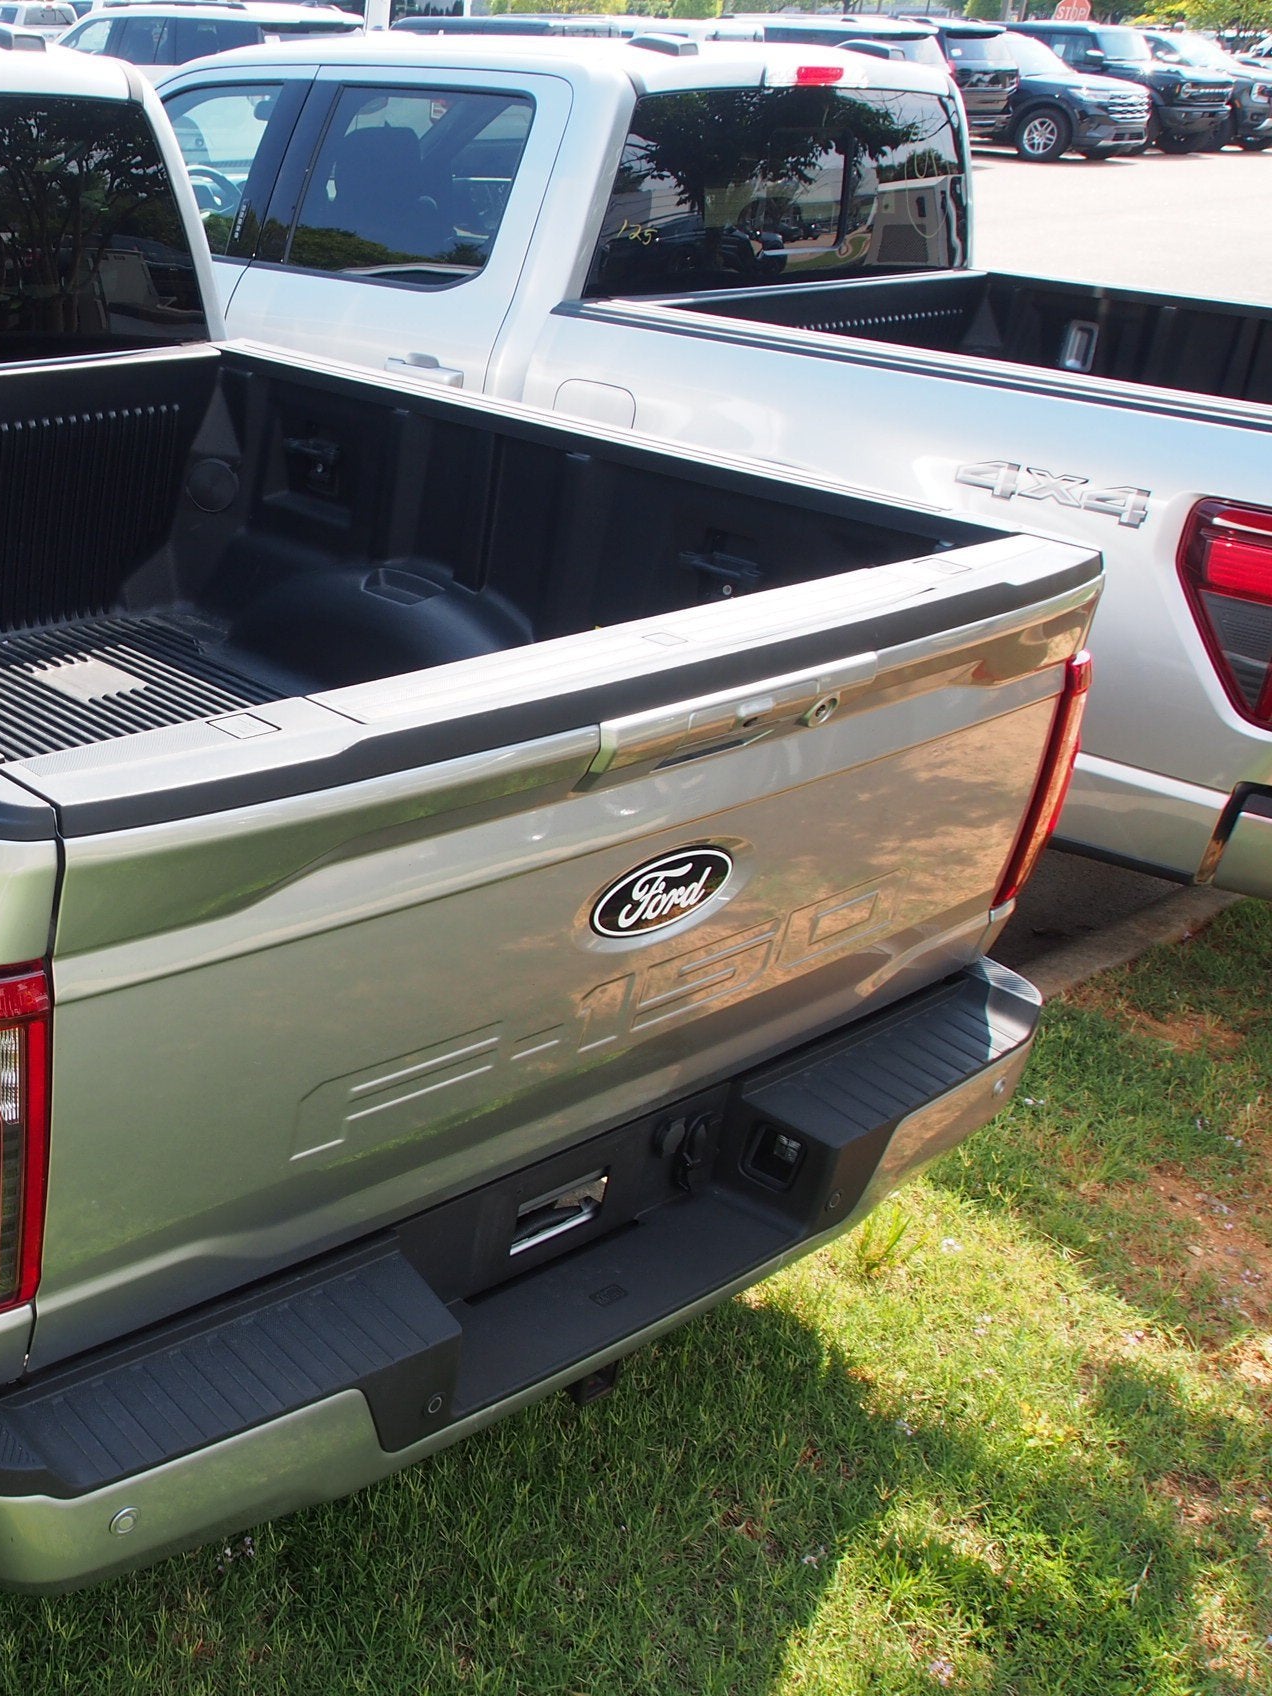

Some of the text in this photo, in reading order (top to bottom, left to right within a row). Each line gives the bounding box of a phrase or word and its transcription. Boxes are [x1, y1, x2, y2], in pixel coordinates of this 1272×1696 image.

[1056, 6, 1087, 20] STOP
[617, 862, 713, 929] Ford
[289, 868, 912, 1161] F-150
